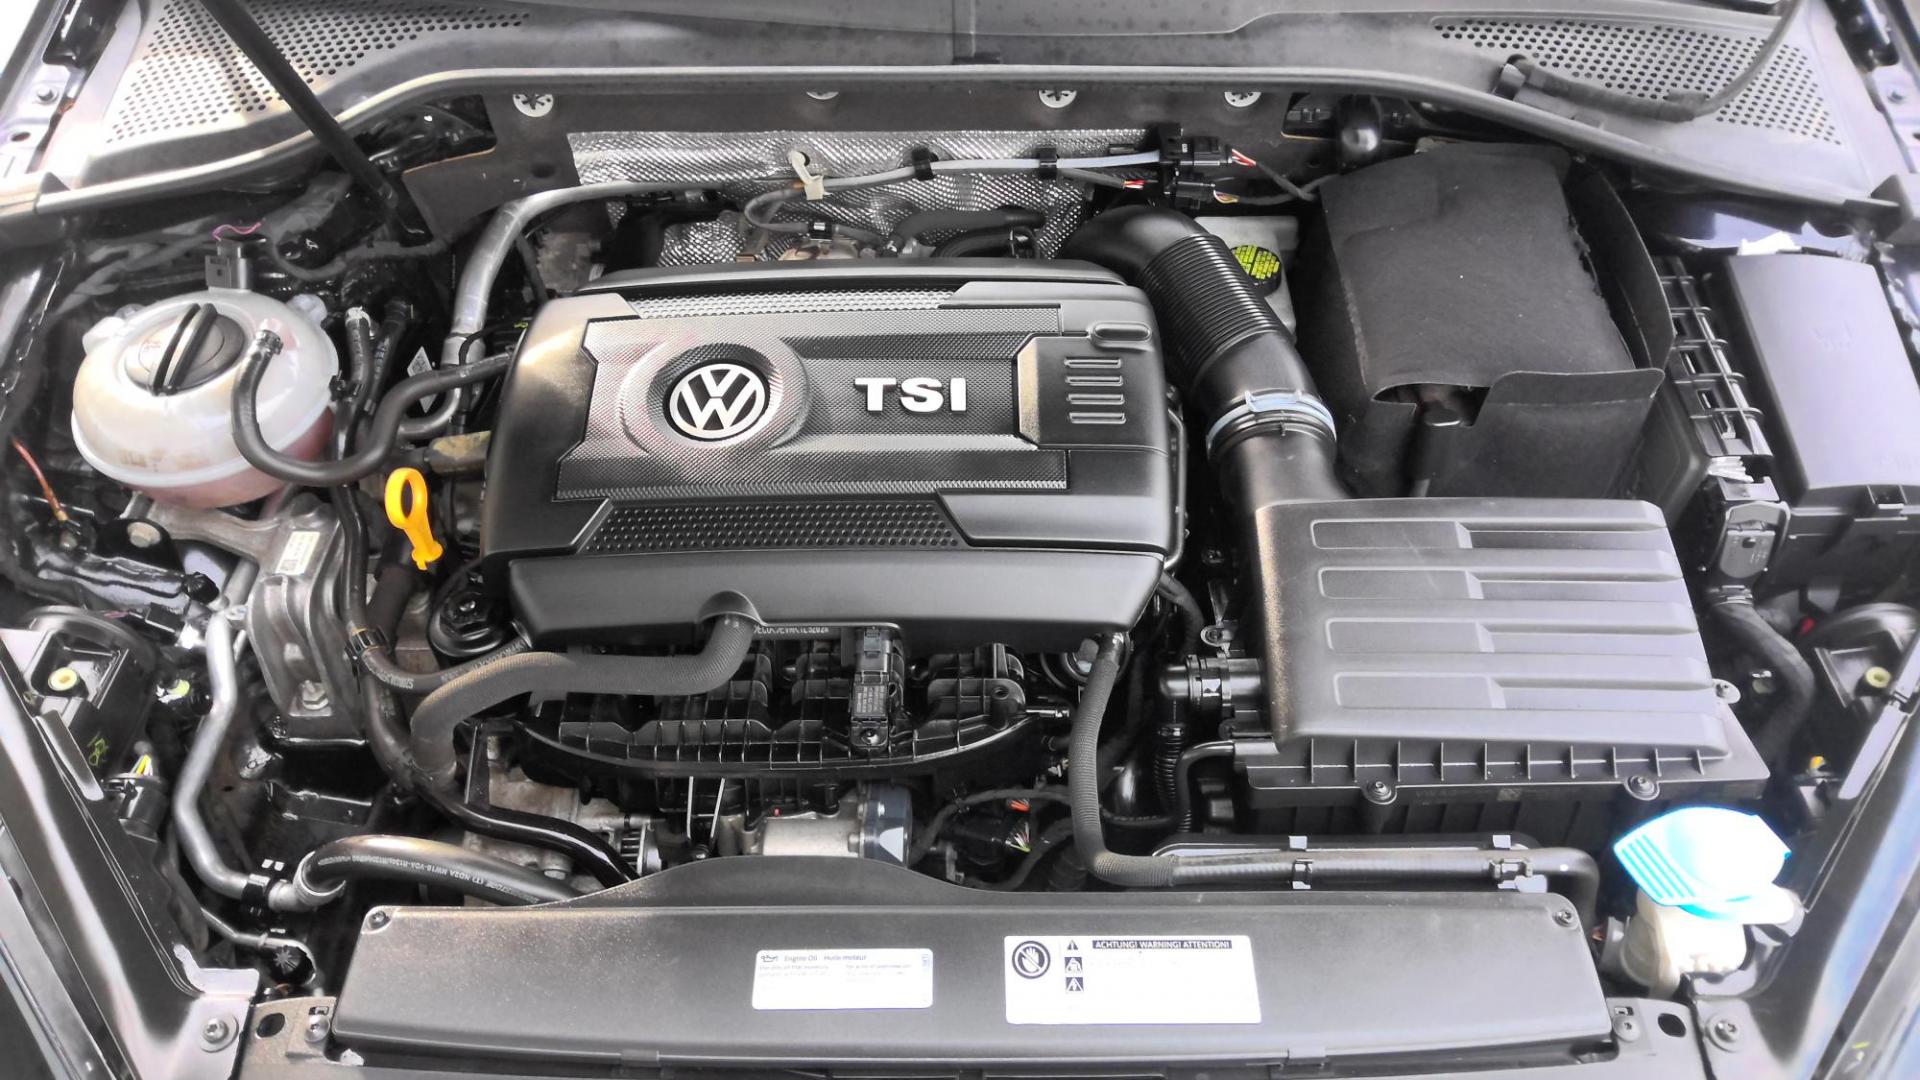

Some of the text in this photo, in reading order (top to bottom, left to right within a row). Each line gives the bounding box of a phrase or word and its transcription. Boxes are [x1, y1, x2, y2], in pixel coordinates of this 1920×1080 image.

[669, 363, 766, 439] VW
[854, 377, 967, 413] TSI
[1095, 940, 1230, 949] ACHTUNG! WARNING! ATTENTION!
